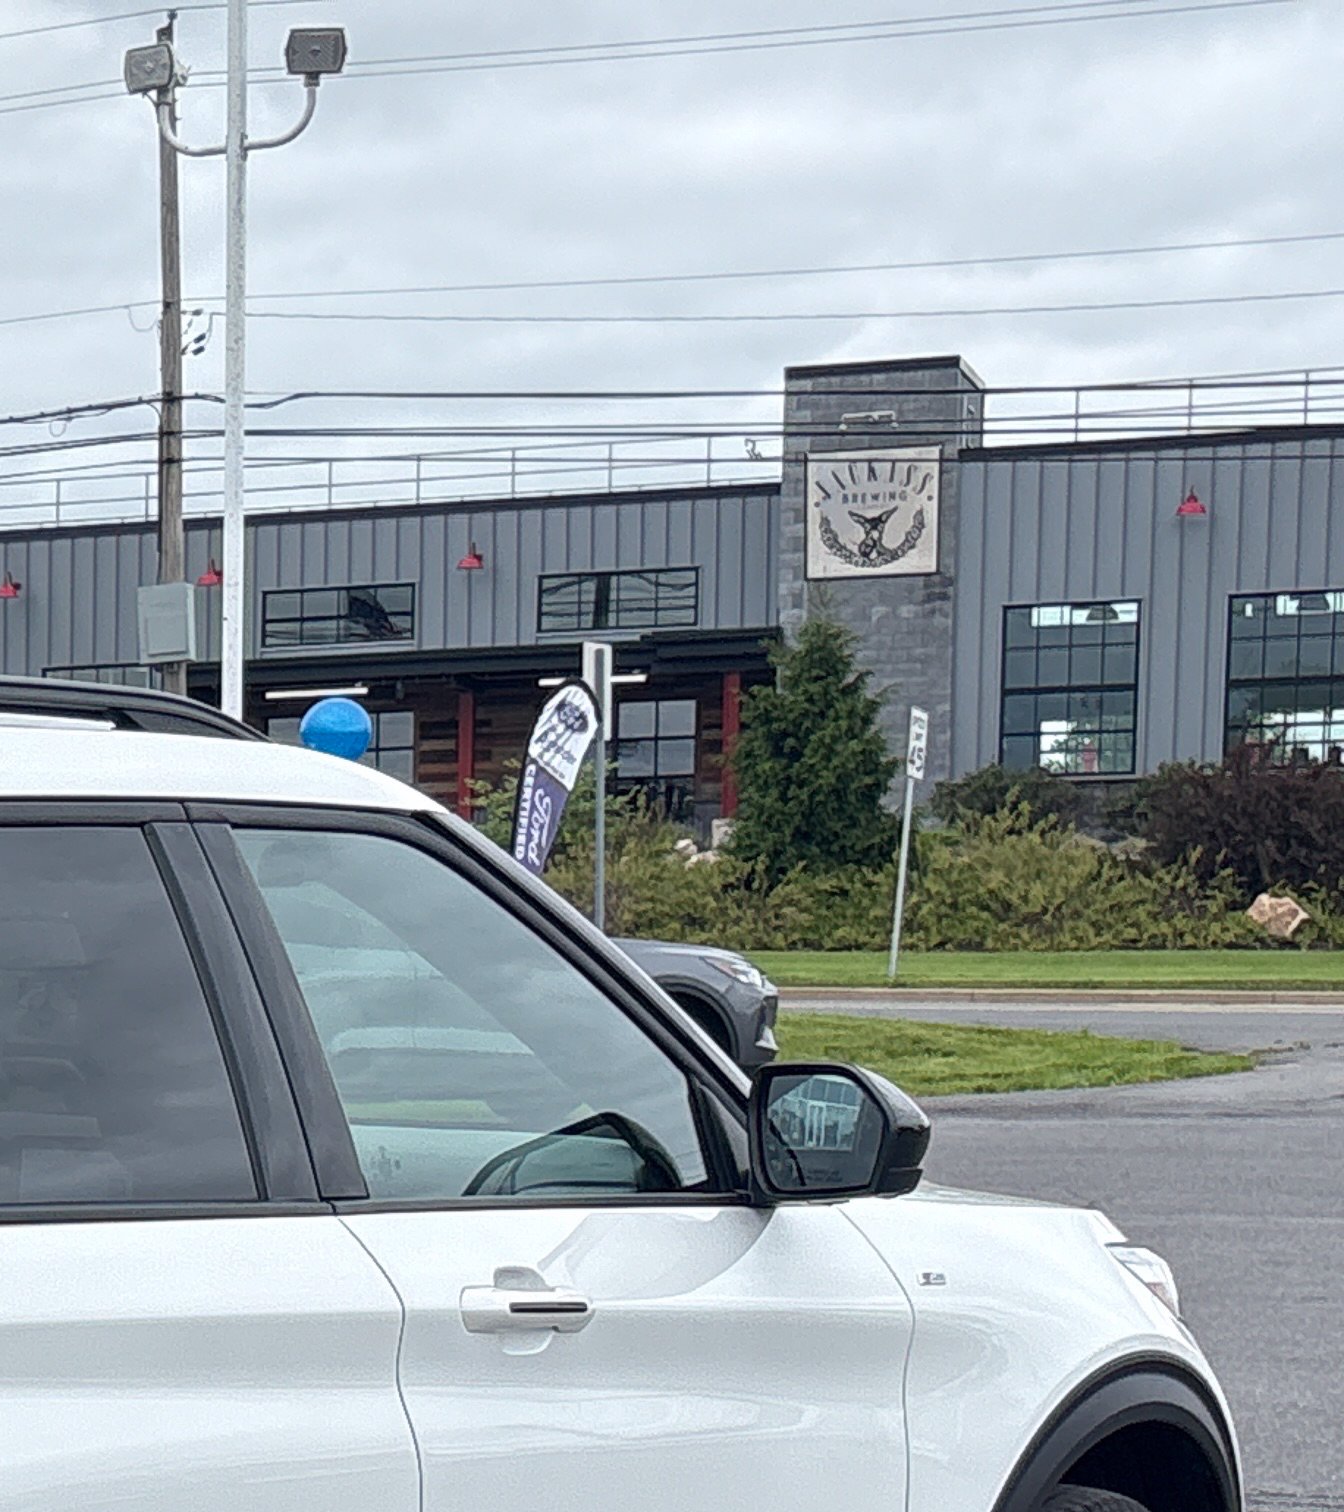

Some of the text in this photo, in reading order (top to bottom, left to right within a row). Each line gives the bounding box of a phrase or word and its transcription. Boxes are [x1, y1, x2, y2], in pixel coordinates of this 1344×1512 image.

[841, 490, 909, 505] BREWING
[514, 763, 537, 861] CERTIFIED
[527, 787, 552, 868] Ford
